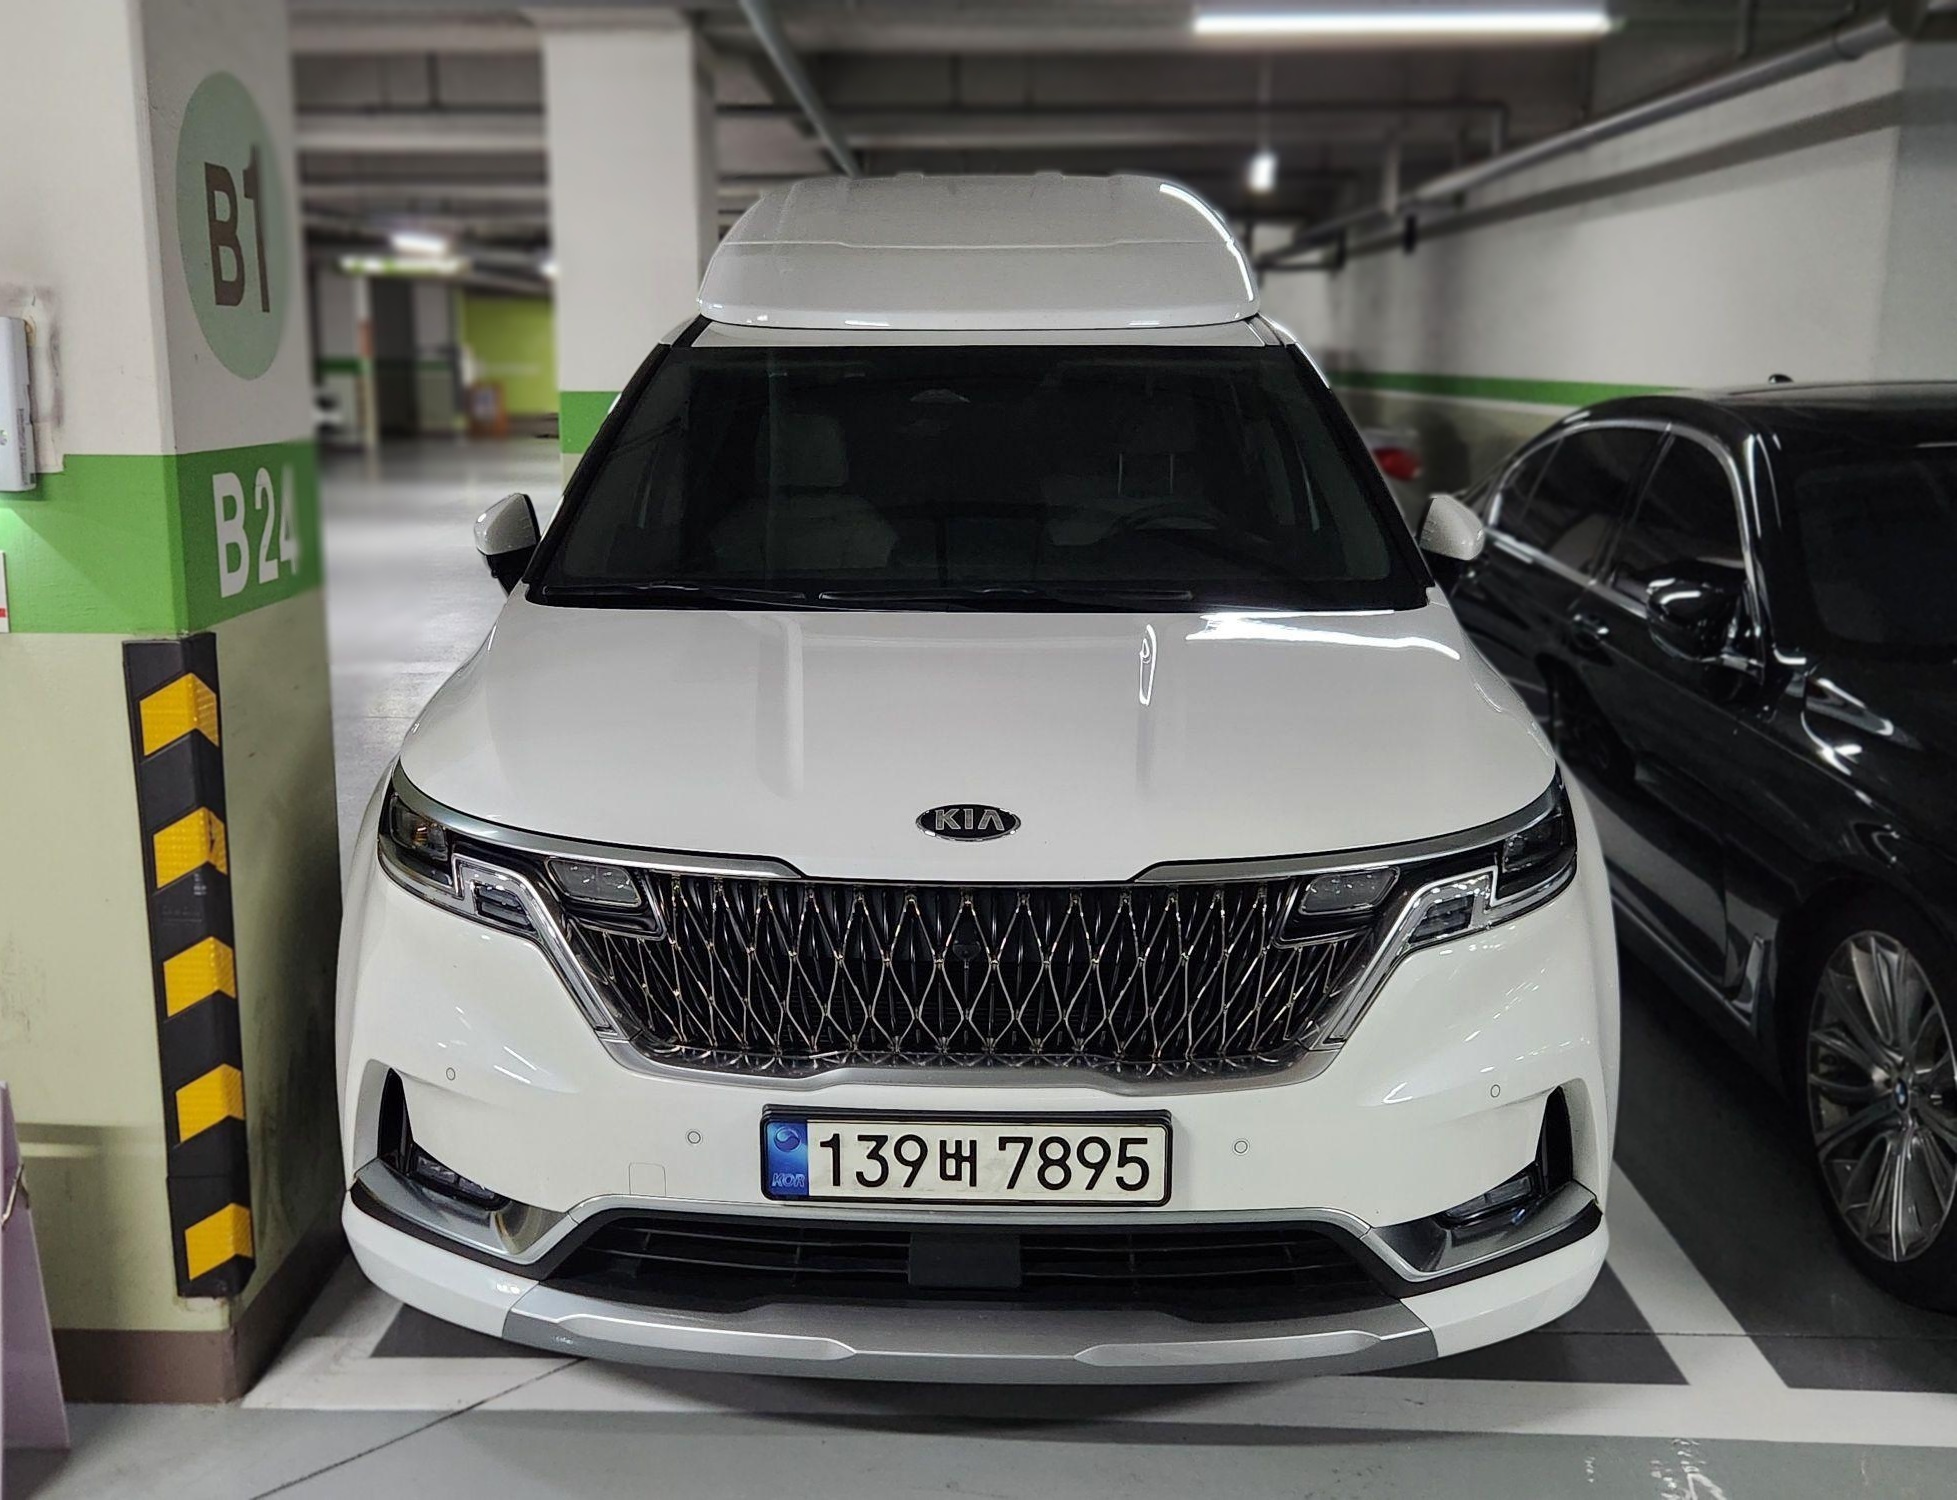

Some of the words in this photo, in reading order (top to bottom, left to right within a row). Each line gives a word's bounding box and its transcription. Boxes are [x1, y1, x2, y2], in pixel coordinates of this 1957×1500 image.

[204, 143, 270, 313] B1
[212, 462, 297, 598] B24
[935, 808, 1005, 831] KIA
[771, 1172, 806, 1187] KOR
[820, 1133, 977, 1187] 139버
[998, 1136, 1150, 1191] 7895
